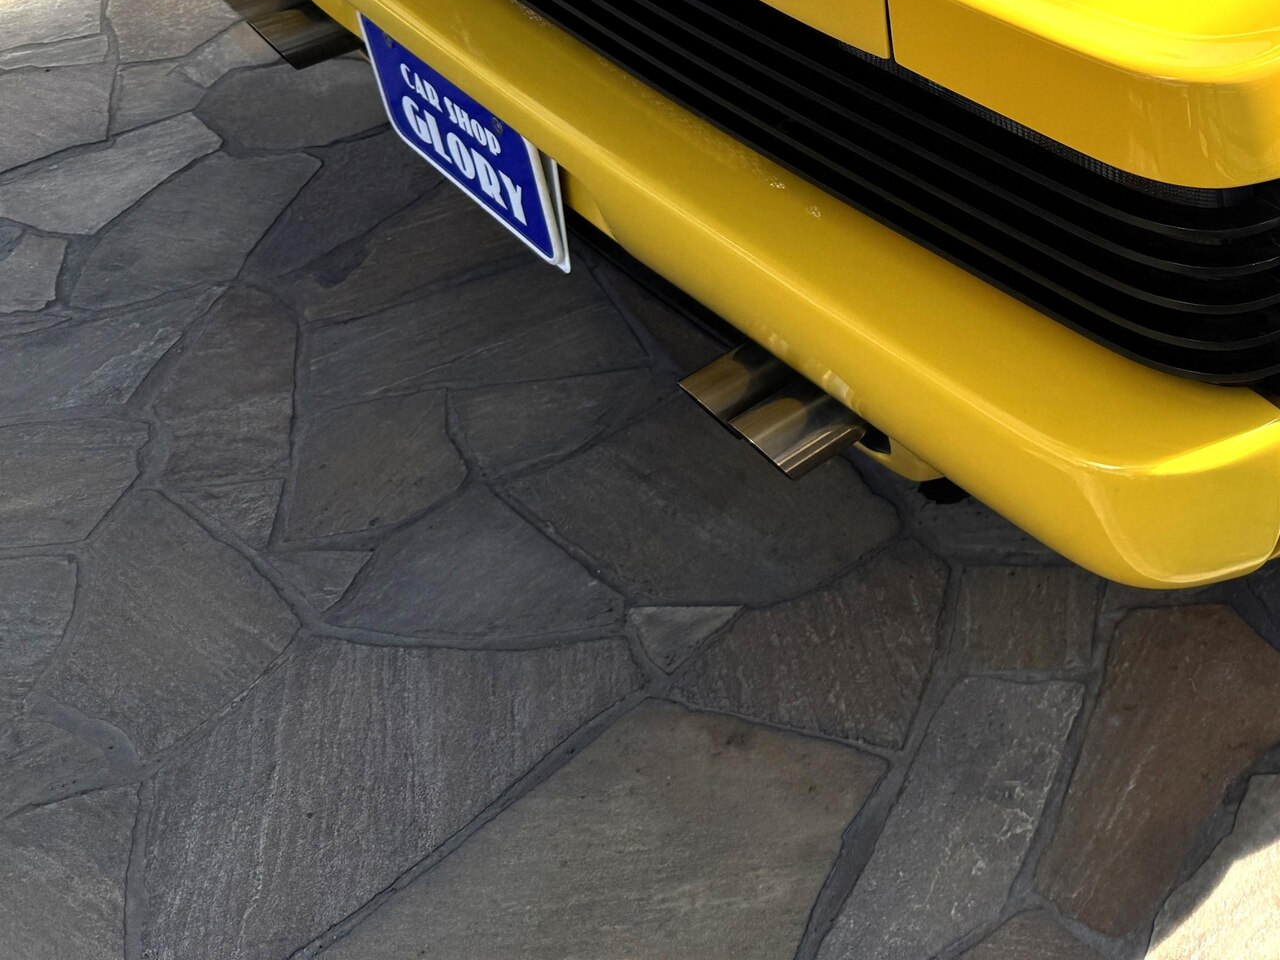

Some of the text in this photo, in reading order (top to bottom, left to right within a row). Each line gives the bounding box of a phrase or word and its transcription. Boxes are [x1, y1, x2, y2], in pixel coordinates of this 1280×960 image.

[400, 62, 501, 156] CAR SHOP
[402, 95, 528, 227] GLORY
